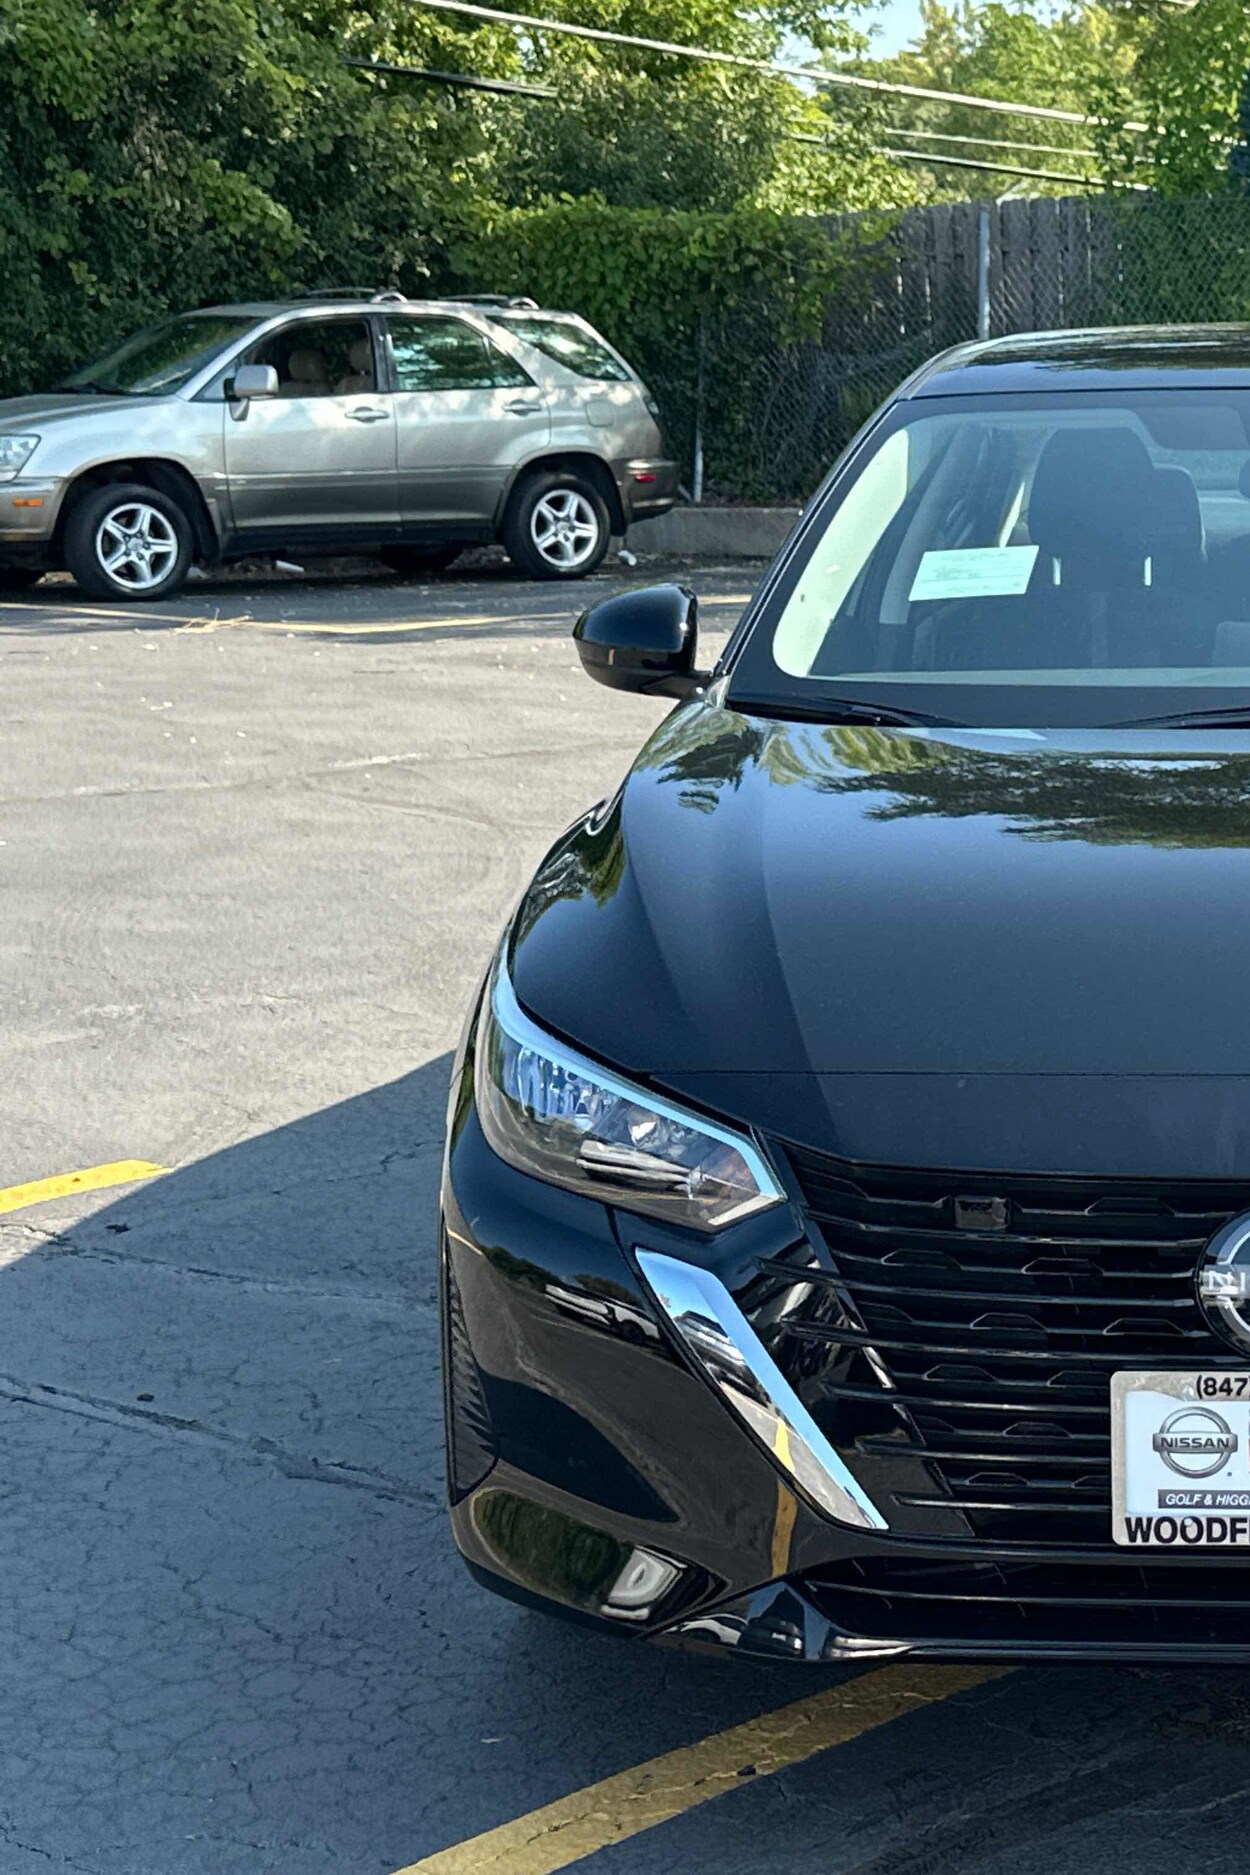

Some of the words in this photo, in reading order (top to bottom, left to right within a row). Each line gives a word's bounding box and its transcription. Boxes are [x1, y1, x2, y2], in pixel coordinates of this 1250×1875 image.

[1160, 1437, 1230, 1449] NISSAN
[1165, 1493, 1203, 1506] GOLF
[1203, 1493, 1213, 1506] &
